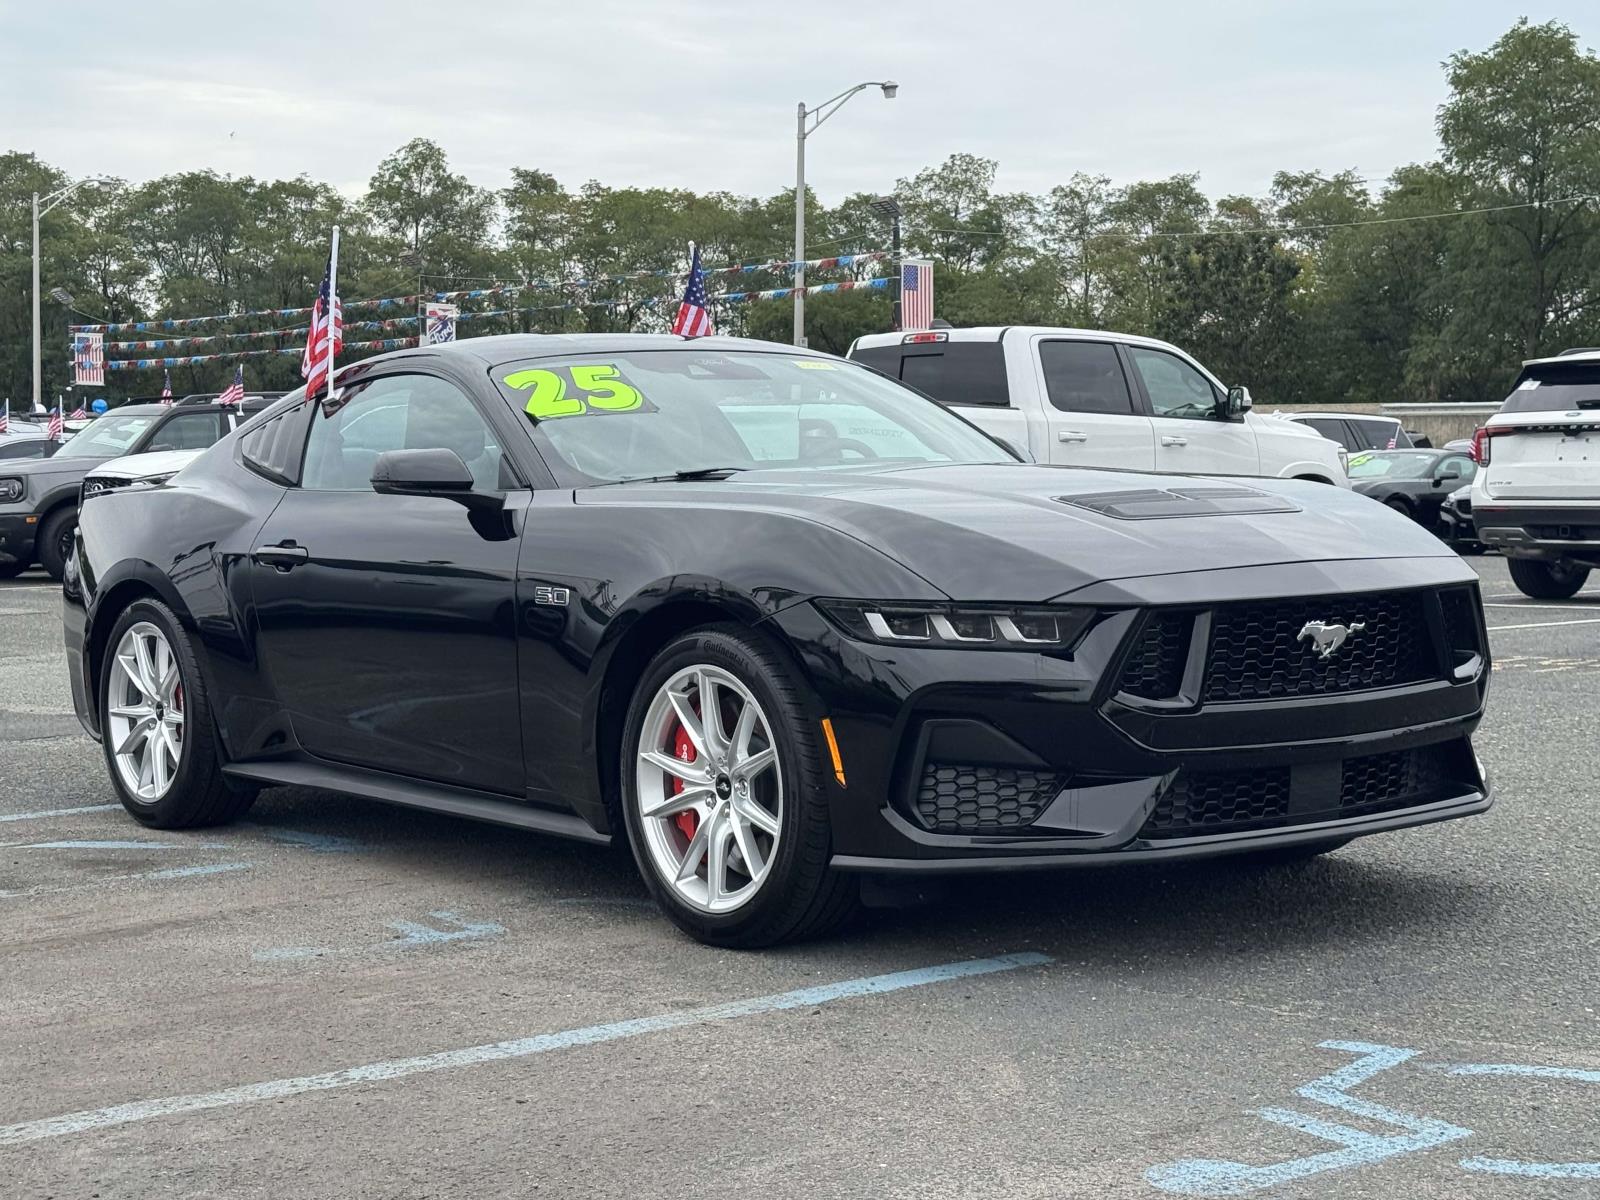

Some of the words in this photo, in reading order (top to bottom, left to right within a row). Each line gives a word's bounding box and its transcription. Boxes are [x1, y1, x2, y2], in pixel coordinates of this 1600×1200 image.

[503, 364, 643, 419] 25
[534, 586, 570, 607] 5.0
[703, 640, 745, 667] Continental
